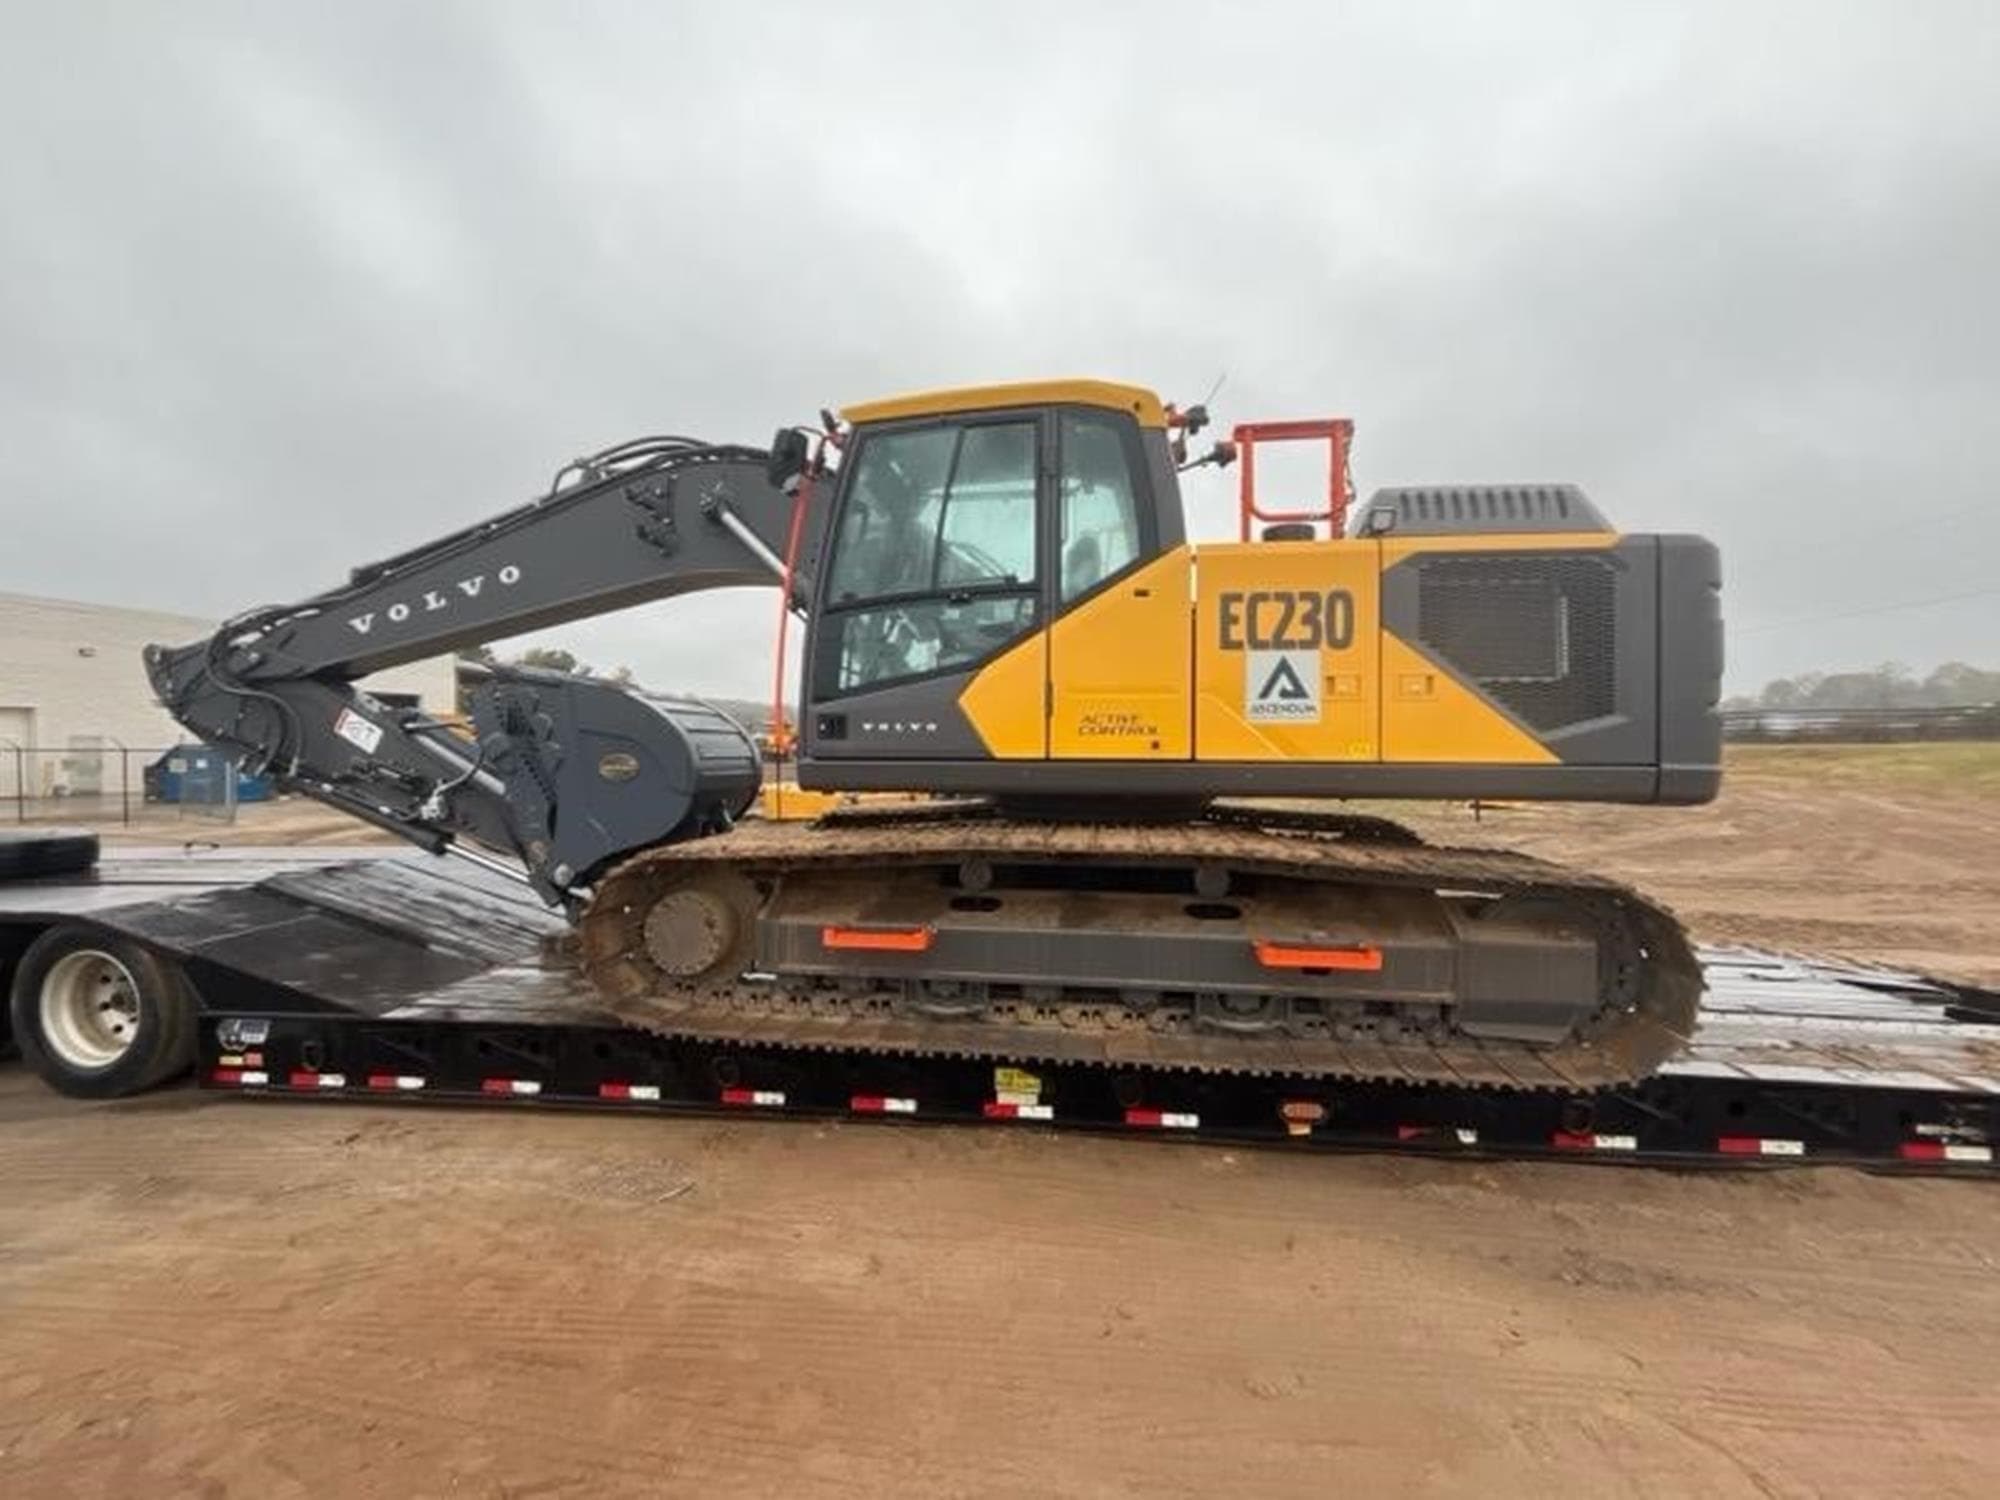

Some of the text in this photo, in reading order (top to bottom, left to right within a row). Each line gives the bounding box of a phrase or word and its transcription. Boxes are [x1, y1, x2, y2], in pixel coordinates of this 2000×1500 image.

[348, 565, 521, 634] VOLVO
[1219, 590, 1355, 650] EC230
[861, 722, 938, 732] VOLVO
